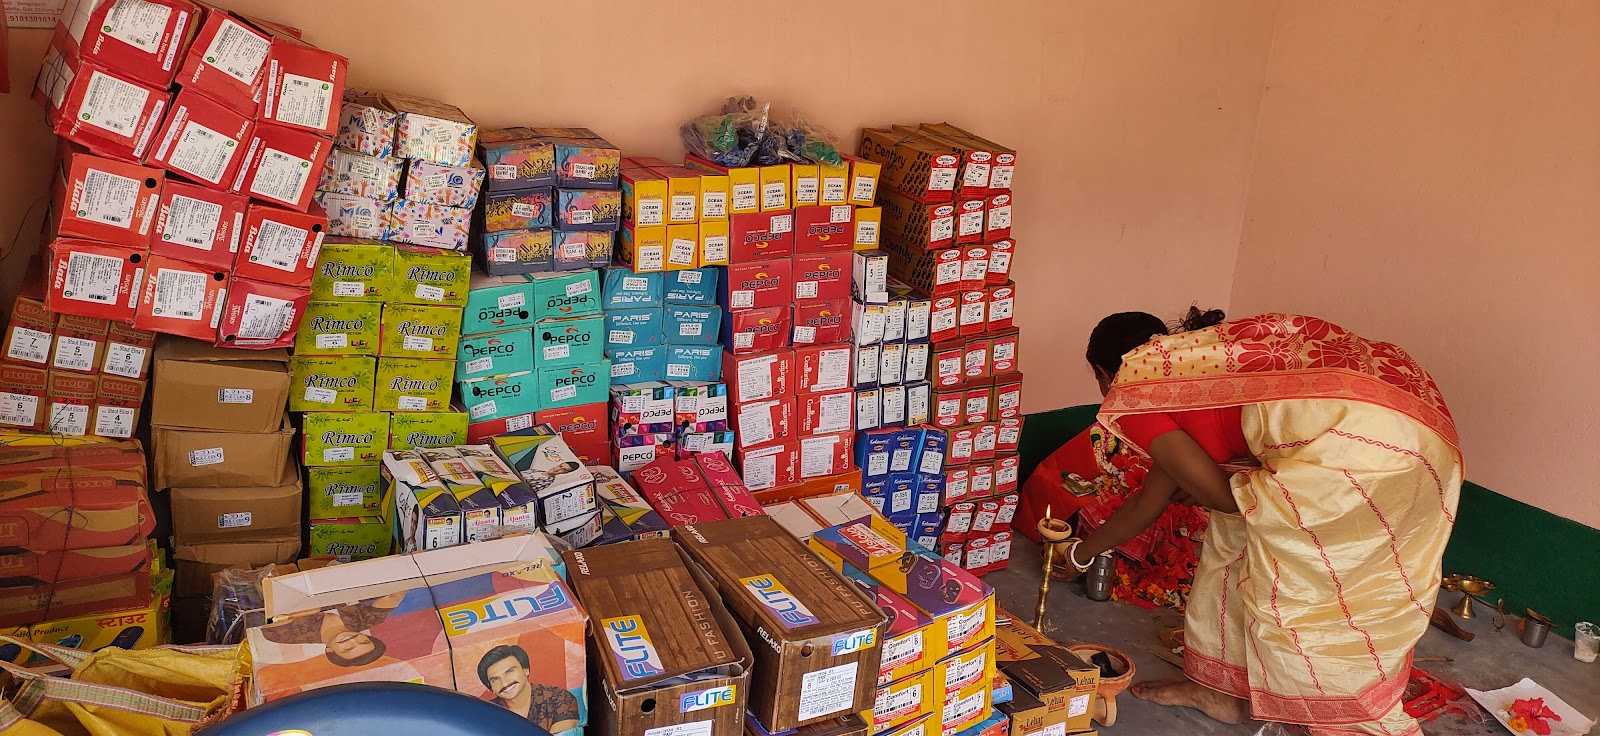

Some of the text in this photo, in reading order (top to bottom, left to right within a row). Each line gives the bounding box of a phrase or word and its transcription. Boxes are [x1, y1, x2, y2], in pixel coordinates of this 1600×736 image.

[92, 34, 104, 55] Bata
[192, 63, 205, 84] Bata
[329, 60, 338, 82] Bata
[236, 120, 250, 140] Bata
[310, 141, 322, 162] Bata
[70, 178, 84, 212] Bata
[156, 203, 170, 234] Bata
[808, 226, 843, 234] PEPCO
[244, 225, 258, 254] Bata
[745, 232, 782, 242] PEPCO
[54, 259, 67, 290] Bata
[321, 261, 375, 278] Rimco
[406, 266, 454, 284] Rimco
[805, 270, 840, 280] PEPCO
[144, 273, 156, 305] Bata
[742, 278, 779, 290] PEPCO
[994, 289, 1010, 298] Century
[548, 295, 587, 307] PEPCO
[478, 308, 520, 320] PEPCO
[612, 314, 650, 322] PARIS
[310, 316, 363, 332] Rimco
[806, 316, 840, 326] PEPCO
[398, 320, 446, 338] Rimco
[746, 324, 780, 334] PEPCO
[551, 333, 590, 344] PEPCO
[472, 344, 514, 357] PEPCO
[616, 350, 654, 358] PARIS
[2, 371, 40, 380] STOUT
[304, 372, 358, 390] Rimco
[556, 374, 595, 386] PEPCO
[54, 378, 92, 389] STOUT
[104, 382, 138, 392] STOUT
[390, 376, 438, 393] Rimco
[480, 384, 520, 398] PEPCO
[643, 408, 672, 418] PEPCO
[699, 406, 724, 415] PEPCO
[559, 421, 596, 433] PEPCO
[321, 430, 374, 447] Rimco
[406, 430, 454, 448] Rimco
[622, 452, 652, 462] PEPCO
[324, 482, 376, 496] Rimco
[472, 518, 495, 526] Ajanta
[507, 514, 530, 523] Ajanta
[432, 537, 438, 548] 6
[326, 541, 376, 558] Rimco
[574, 551, 591, 576] RELAXO
[799, 553, 871, 616] PU FASHION
[748, 576, 812, 624] FLITE
[448, 586, 565, 630] FLITE
[95, 612, 148, 628] स्टाउट
[683, 590, 720, 646] FASHION
[959, 612, 978, 624] Comfort
[34, 625, 69, 636] Product
[757, 626, 782, 654] RELAXO
[834, 632, 874, 654] FLITE
[888, 637, 911, 650] Comfort
[610, 619, 657, 678] FLITE
[956, 660, 977, 670] Comfort
[1076, 677, 1096, 686] Lehar
[684, 688, 733, 710] FLITE
[886, 688, 909, 701] Comfort
[1047, 696, 1065, 706] Lehar
[954, 696, 974, 708] Comfort
[1026, 716, 1044, 727] Lehar
